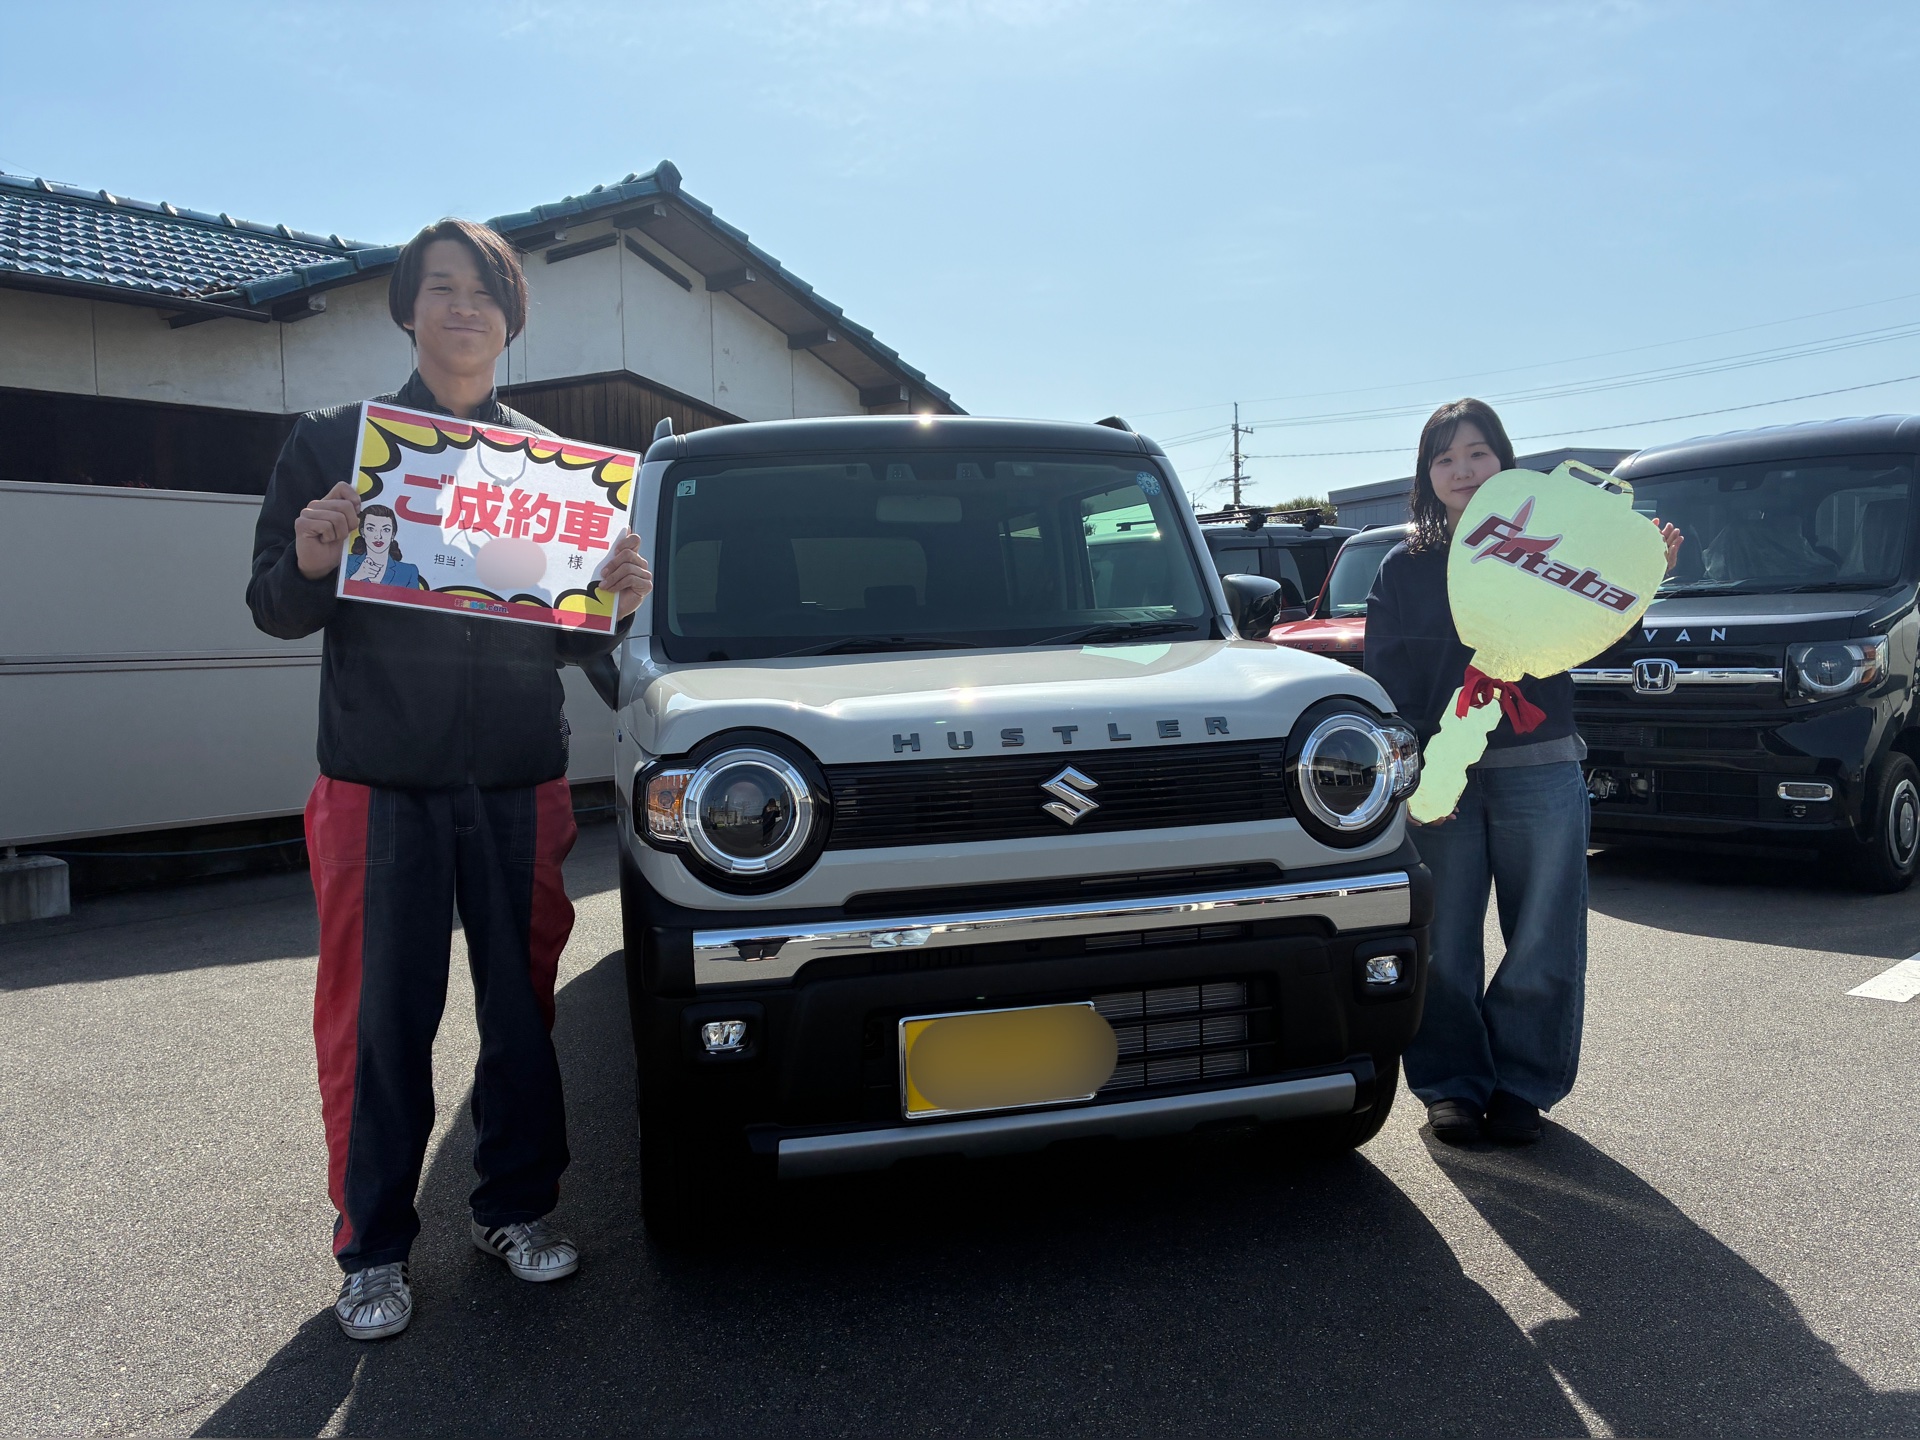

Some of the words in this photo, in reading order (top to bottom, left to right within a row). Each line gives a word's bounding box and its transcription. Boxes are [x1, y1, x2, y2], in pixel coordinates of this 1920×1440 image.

[685, 485, 692, 495] 2
[394, 473, 615, 552] ご成約車
[567, 553, 584, 570] 様
[1462, 513, 1639, 613] Futaba
[1643, 627, 1727, 643] VAN
[892, 716, 1230, 754] HUSTLER
